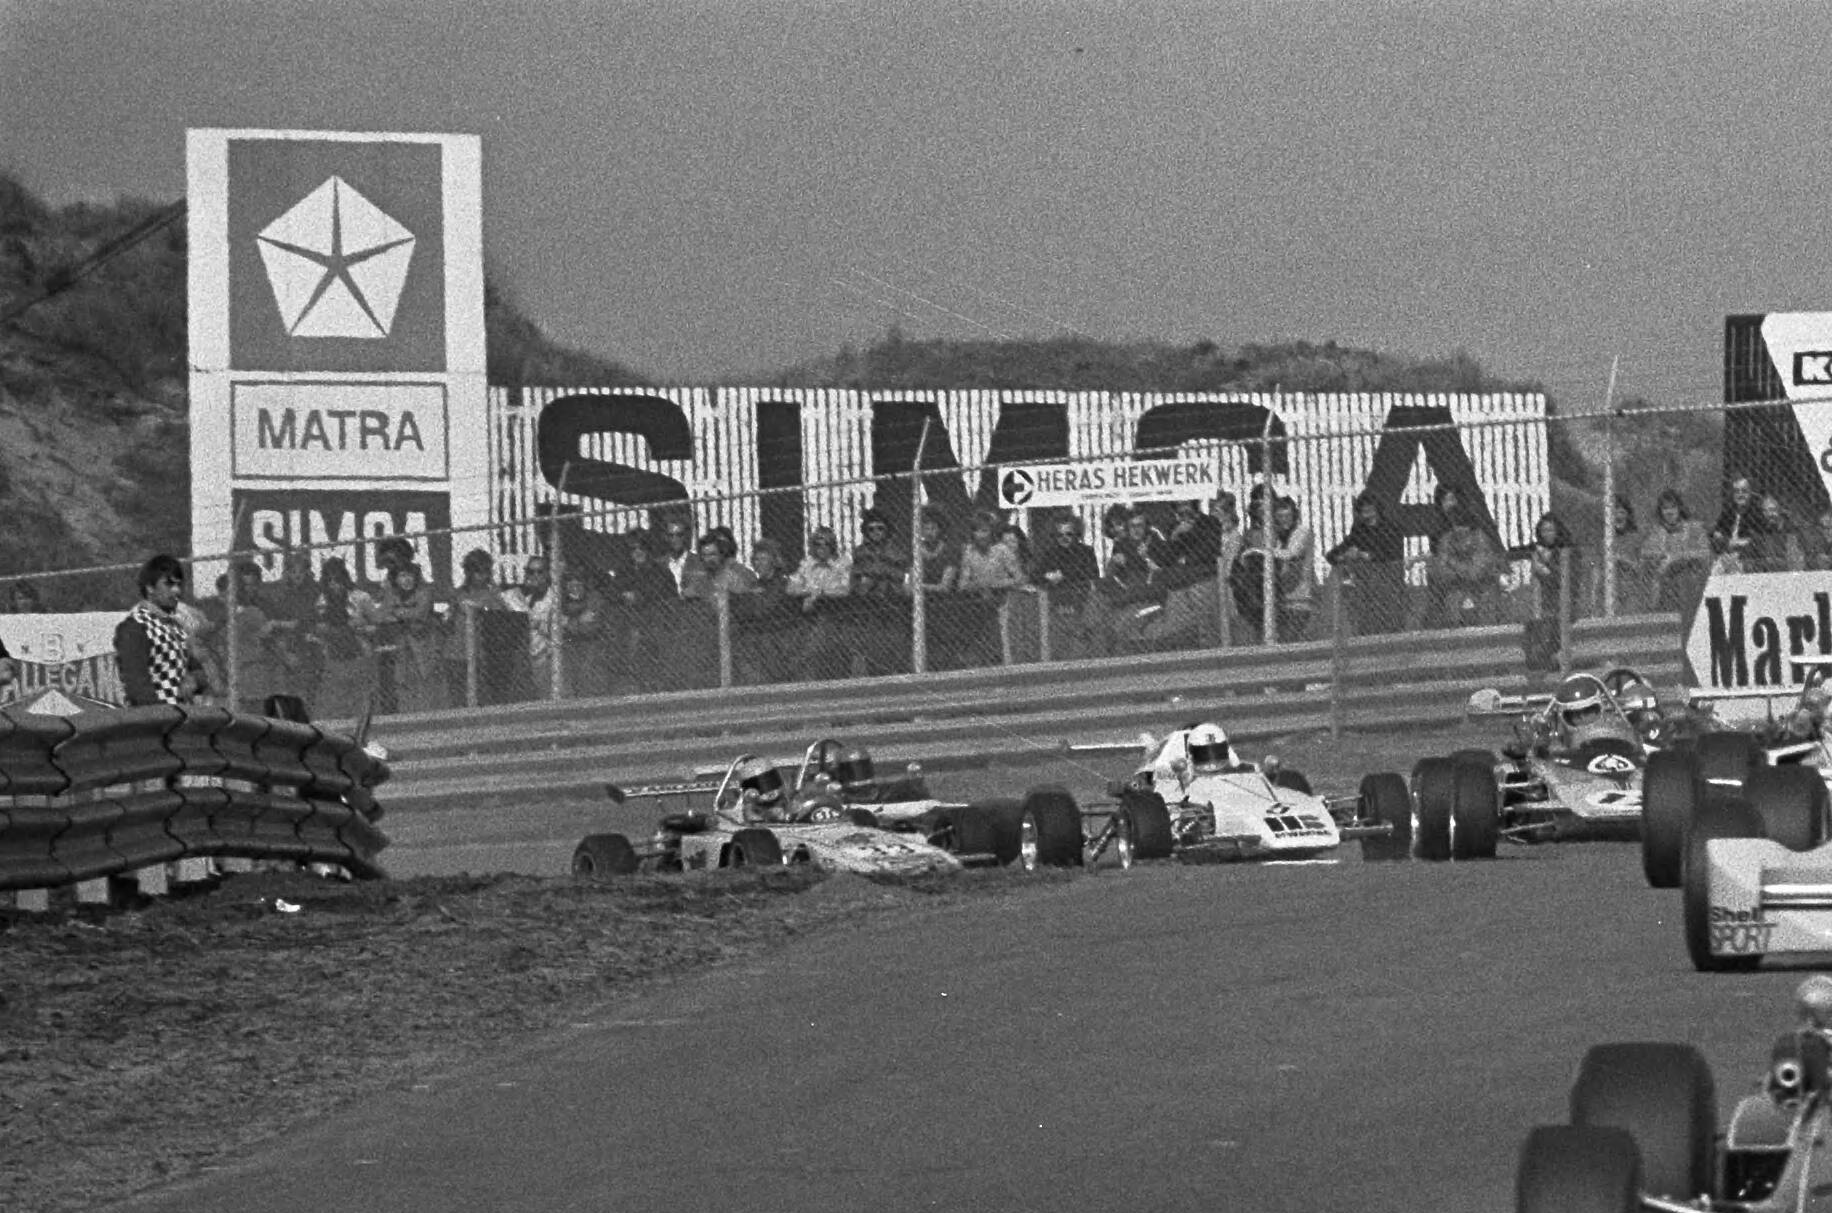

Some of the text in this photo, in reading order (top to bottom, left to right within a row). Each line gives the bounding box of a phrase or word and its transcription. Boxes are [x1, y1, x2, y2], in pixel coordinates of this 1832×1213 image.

[258, 407, 424, 451] MATRA
[1036, 462, 1213, 492] HERAS HEKWERK
